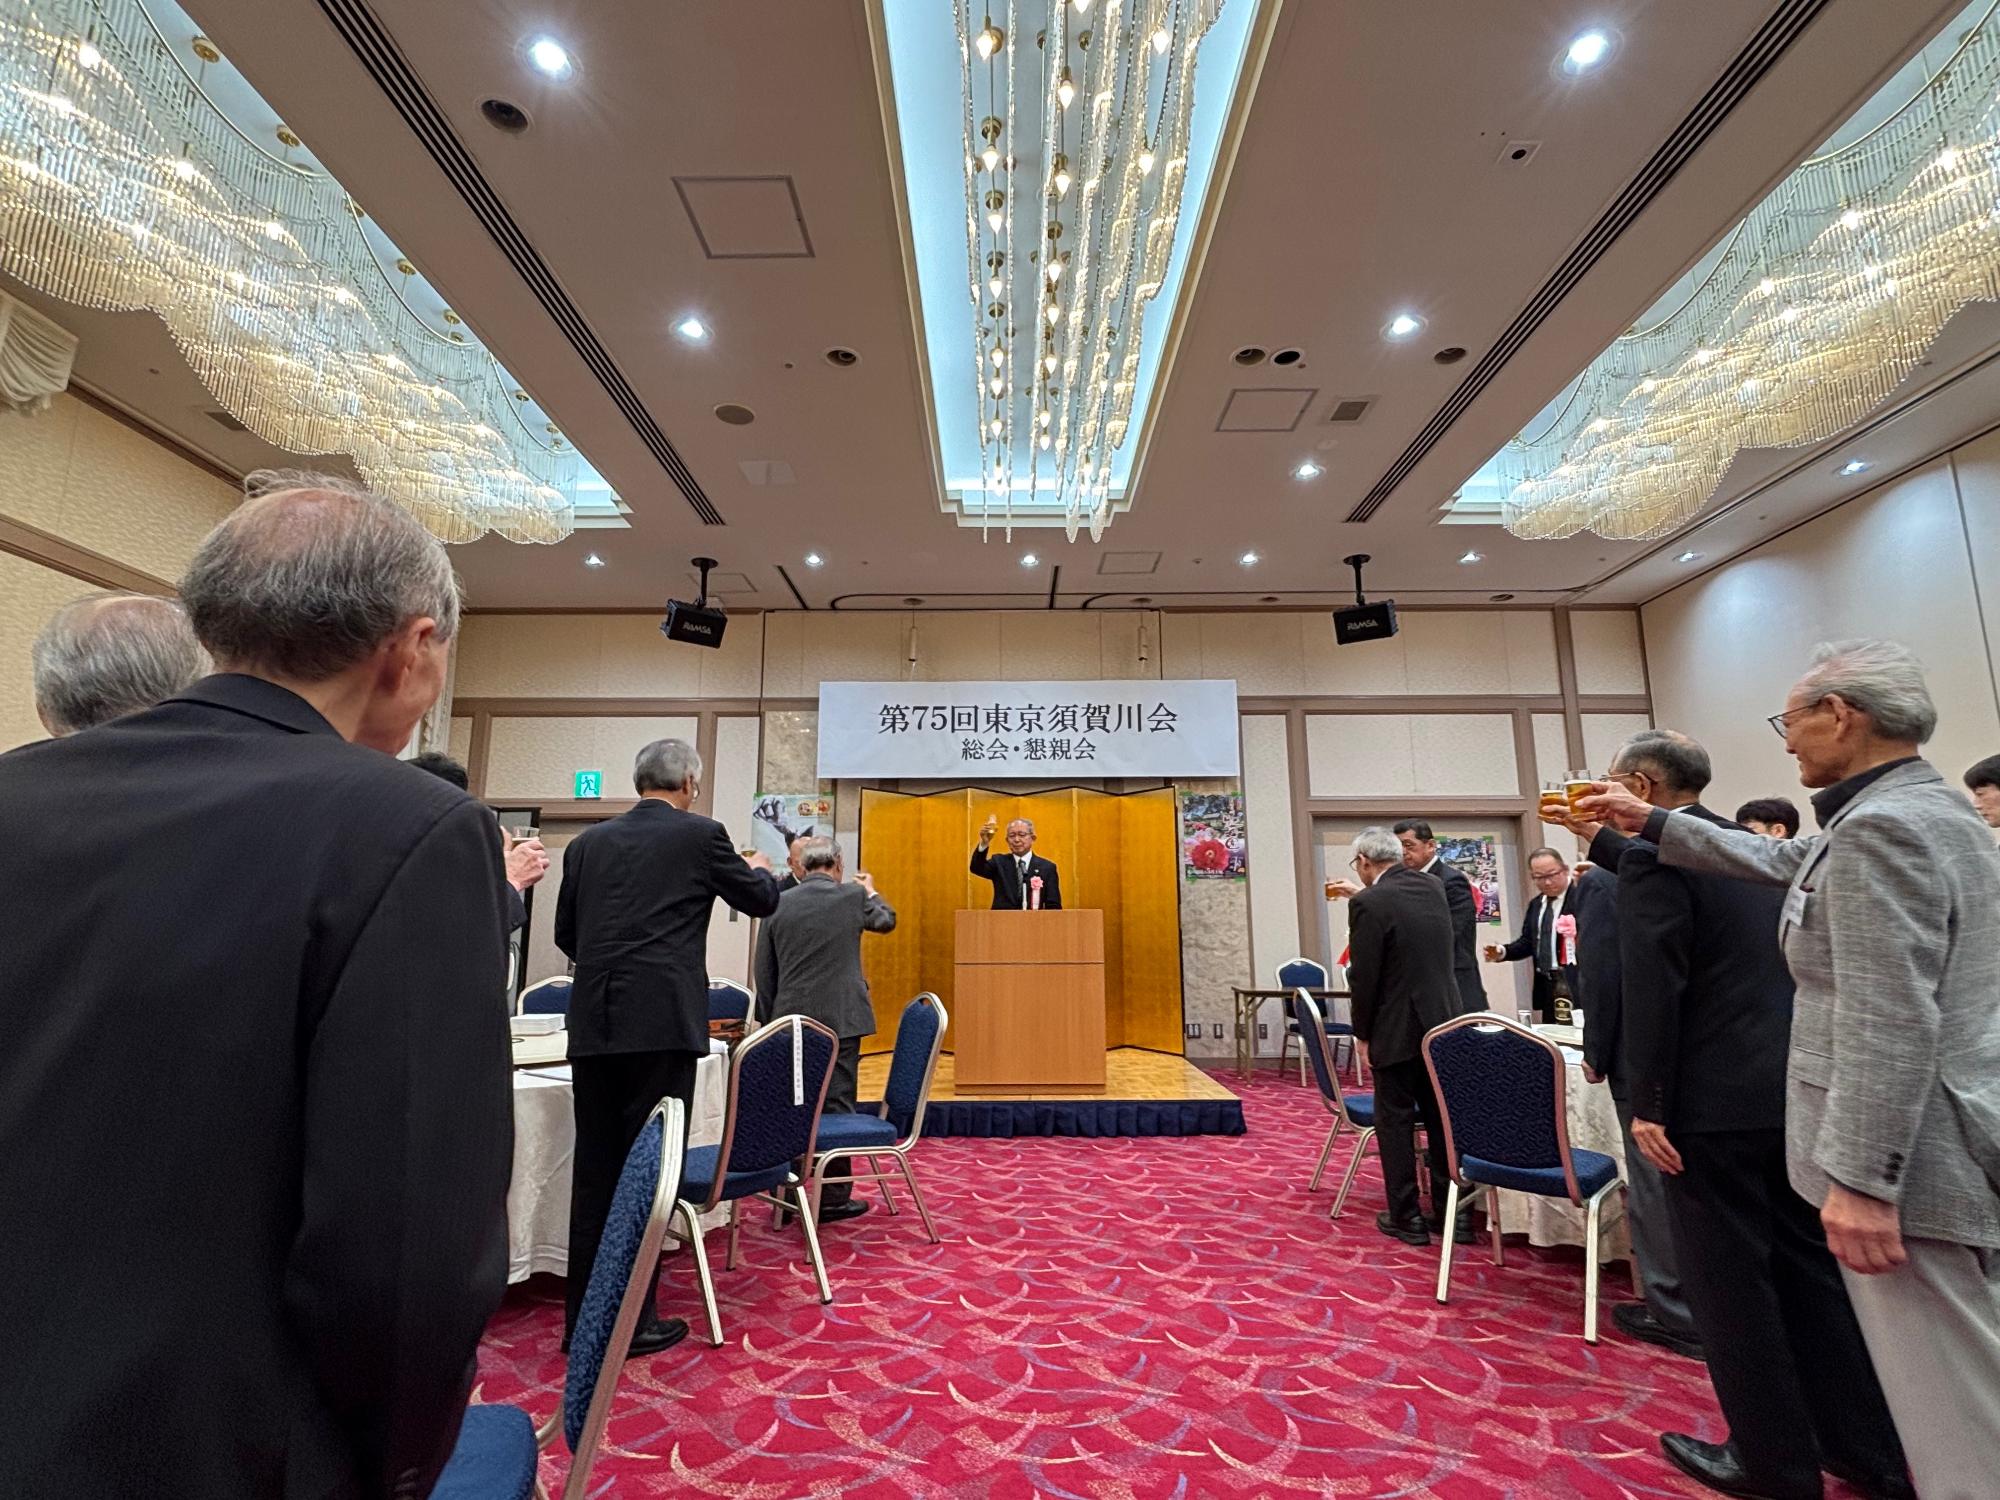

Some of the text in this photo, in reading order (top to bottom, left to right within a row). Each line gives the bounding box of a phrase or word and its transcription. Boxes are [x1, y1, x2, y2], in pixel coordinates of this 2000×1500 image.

[682, 621, 712, 635] RAMSA
[1346, 619, 1378, 631] RAMSA
[878, 702, 1178, 734] 第75回東京須賀川会
[961, 737, 1096, 761] 総会・懇親会
